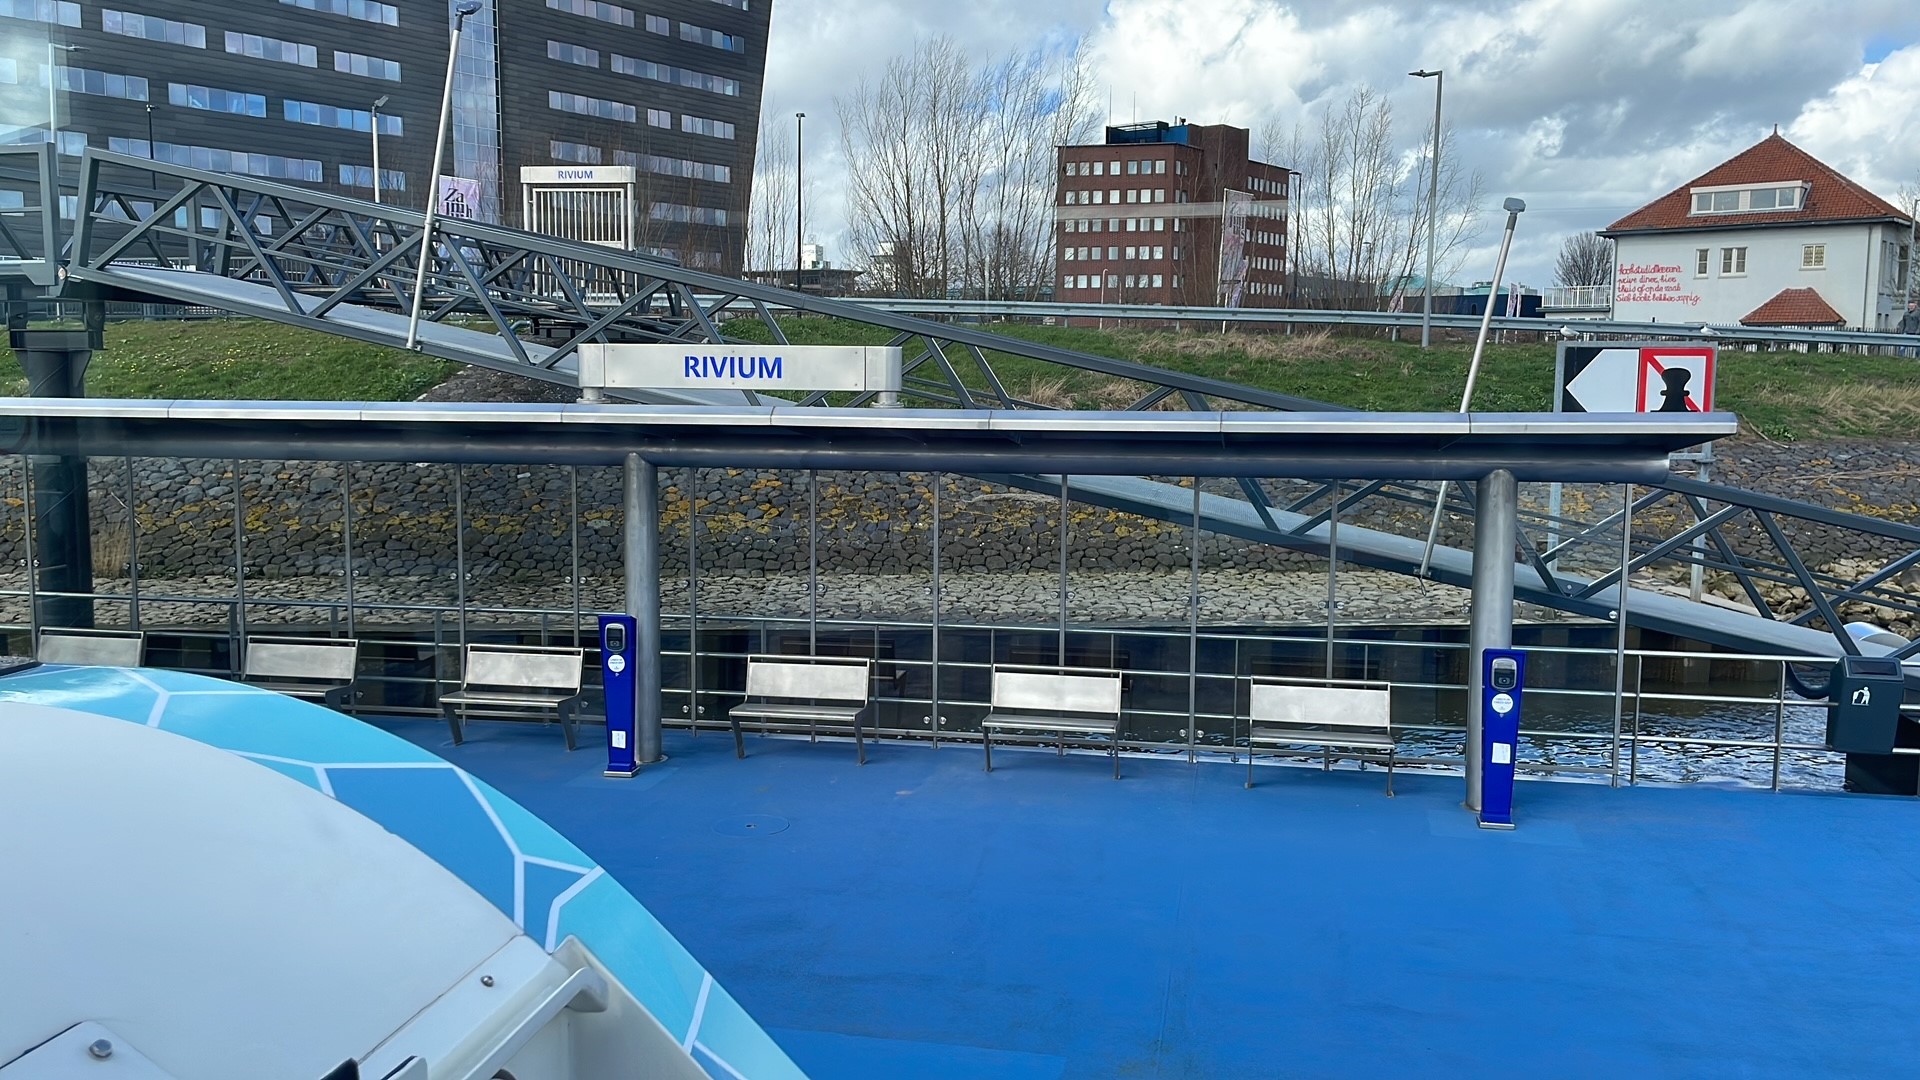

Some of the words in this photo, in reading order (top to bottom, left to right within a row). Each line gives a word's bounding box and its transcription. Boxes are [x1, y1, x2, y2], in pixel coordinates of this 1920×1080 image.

[558, 170, 593, 179] RIVIUM
[444, 188, 464, 203] Za
[684, 356, 783, 379] RIVIUM
